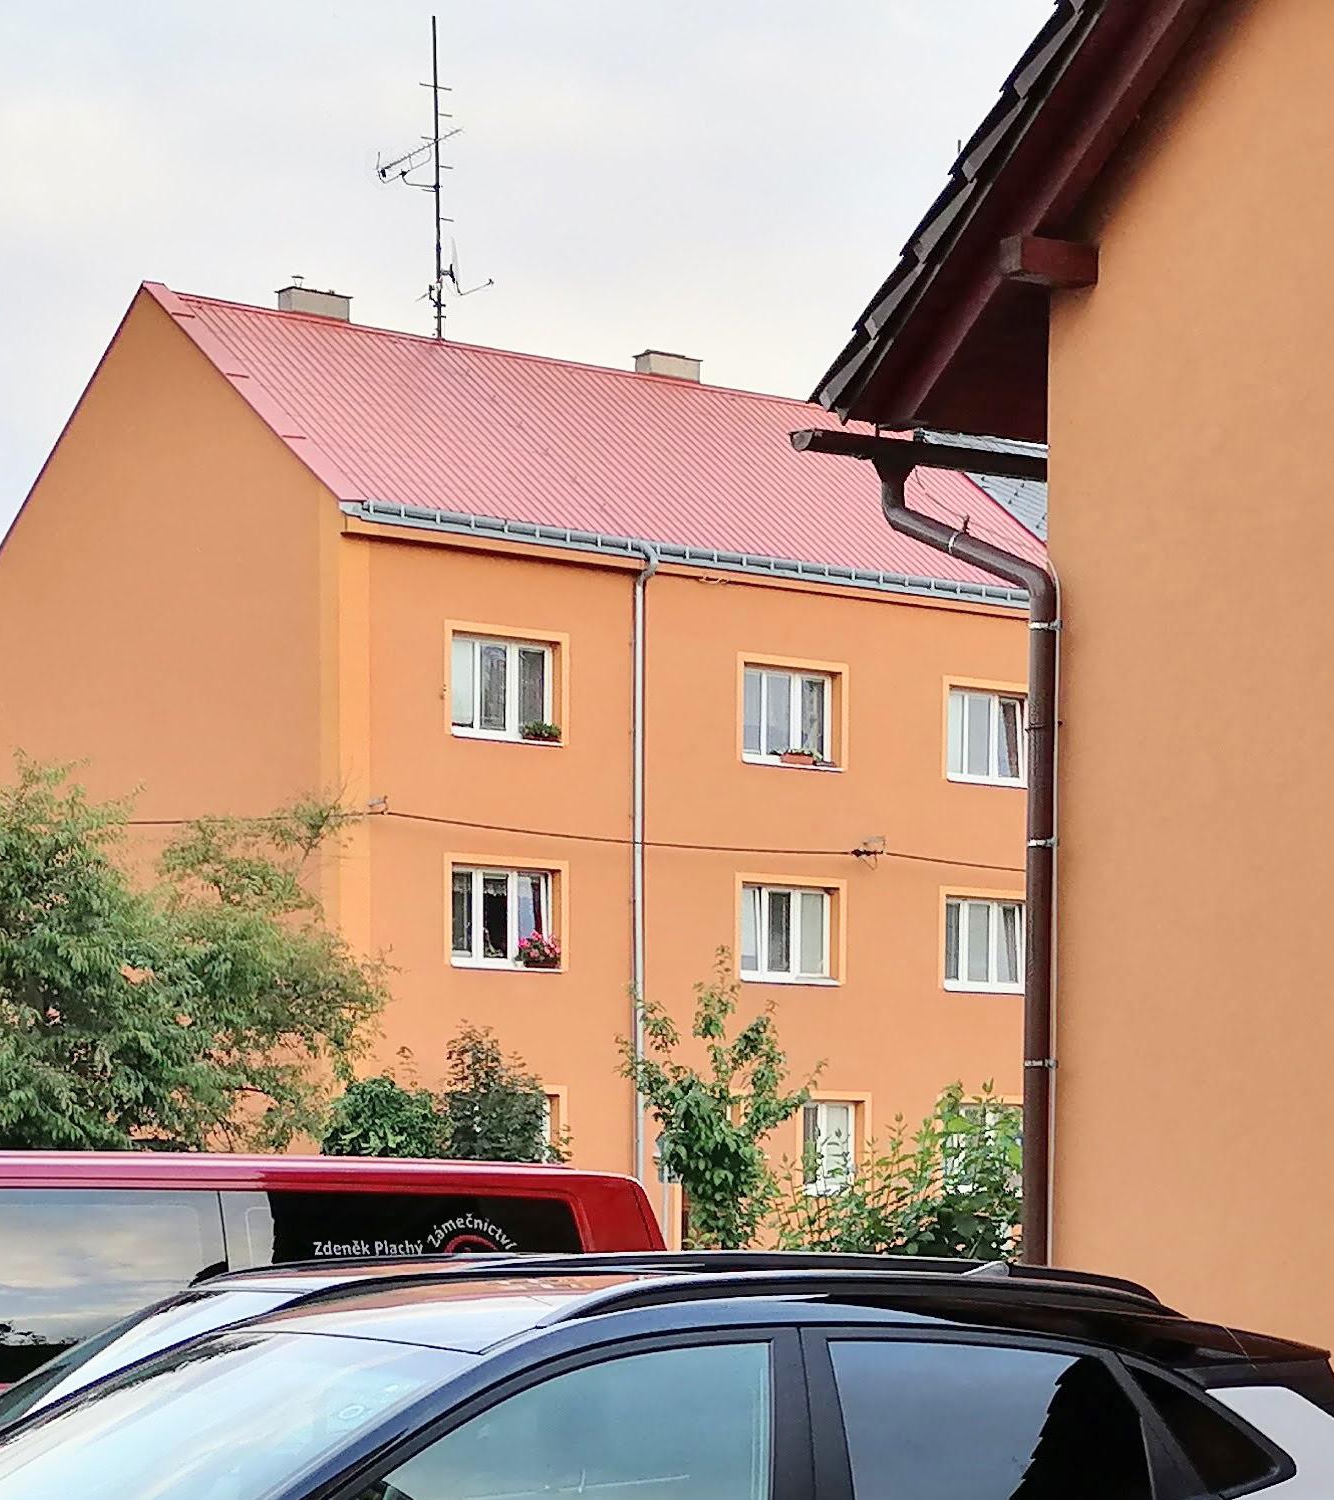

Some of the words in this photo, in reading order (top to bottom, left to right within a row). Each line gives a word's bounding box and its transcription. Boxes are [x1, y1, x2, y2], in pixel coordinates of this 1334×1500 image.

[426, 1213, 518, 1251] Zámečnictví
[313, 1239, 371, 1256] Zdeněk
[374, 1239, 424, 1257] Plachý
